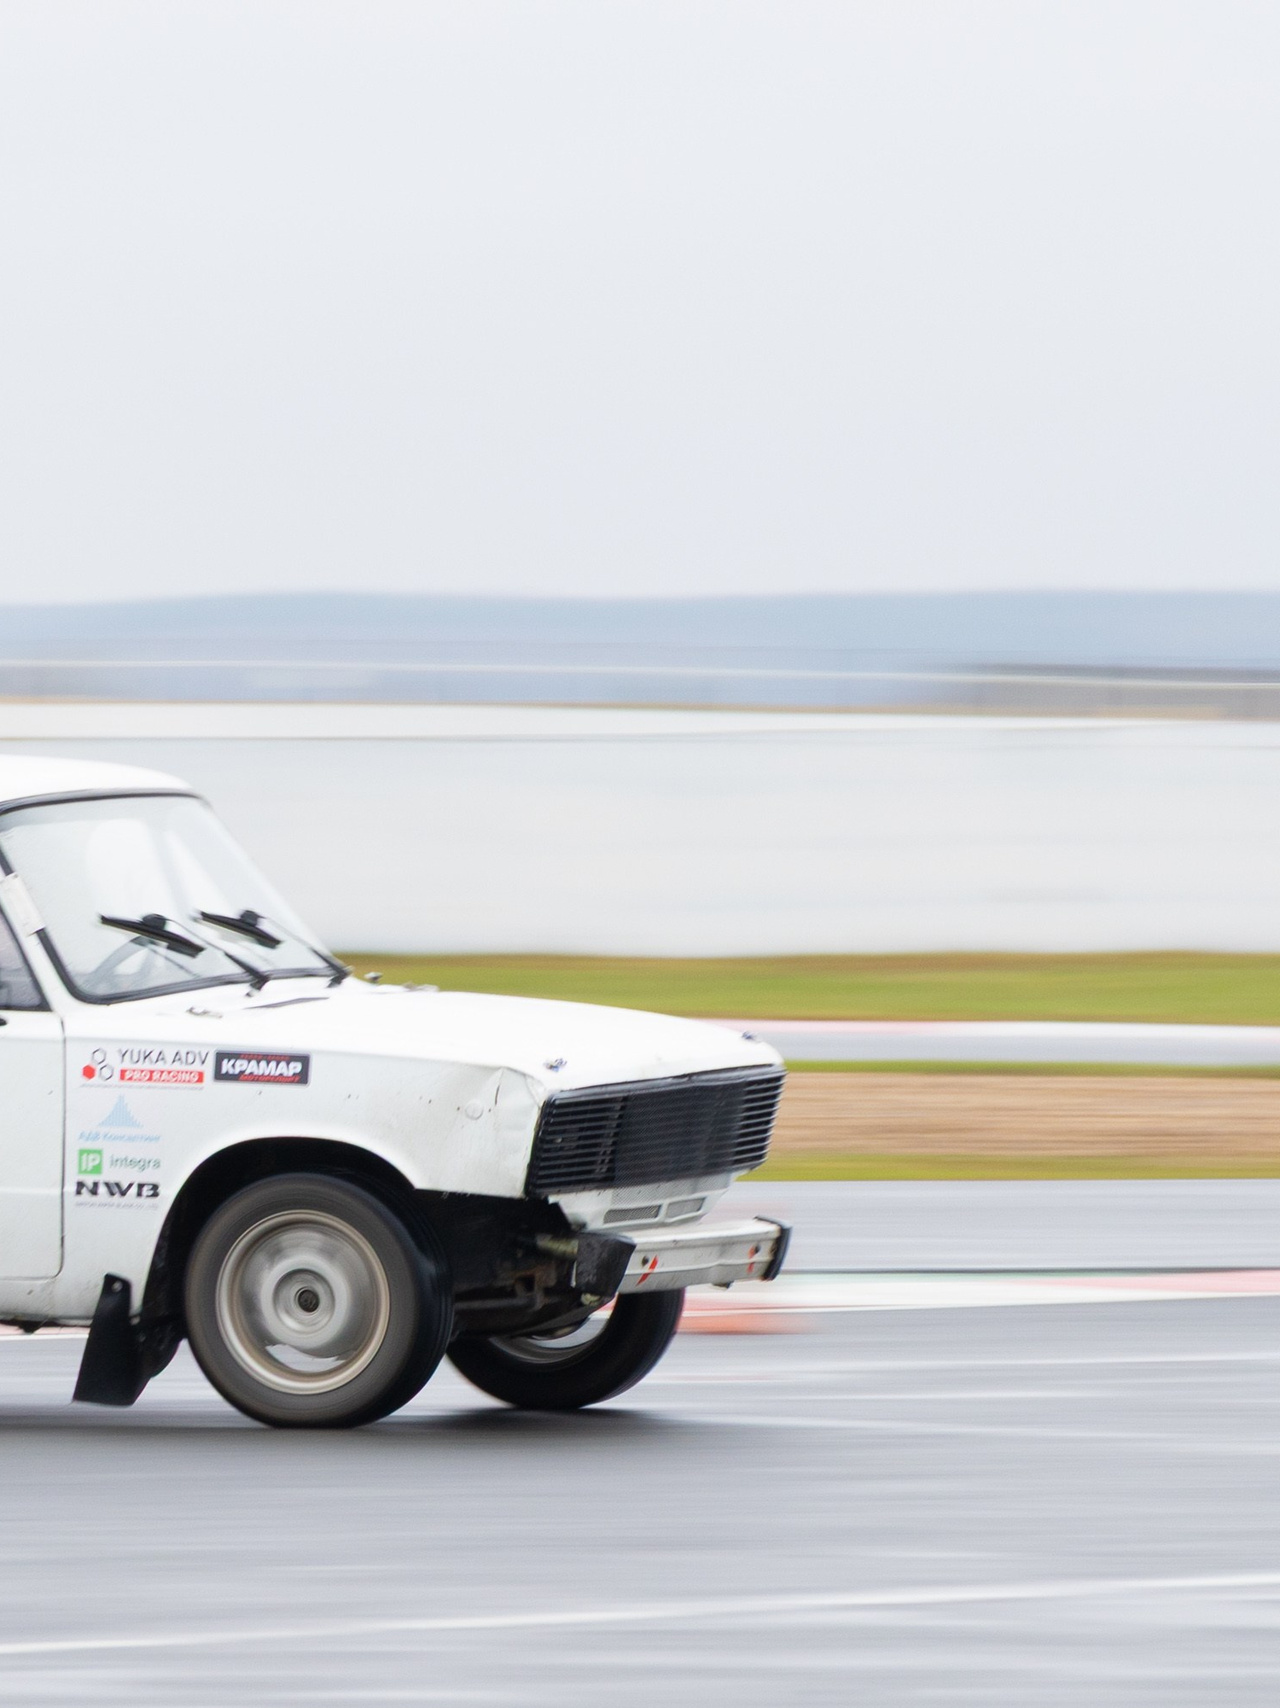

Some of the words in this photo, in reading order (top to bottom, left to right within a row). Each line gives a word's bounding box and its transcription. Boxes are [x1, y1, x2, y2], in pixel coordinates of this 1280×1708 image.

[119, 1048, 166, 1065] YUKA
[171, 1050, 209, 1066] ADV
[124, 1070, 150, 1081] PRO
[152, 1070, 199, 1083] RACING
[221, 1058, 302, 1077] КРАМАР
[81, 1152, 100, 1172] IP
[110, 1154, 161, 1172] integra
[75, 1180, 160, 1198] NWB
